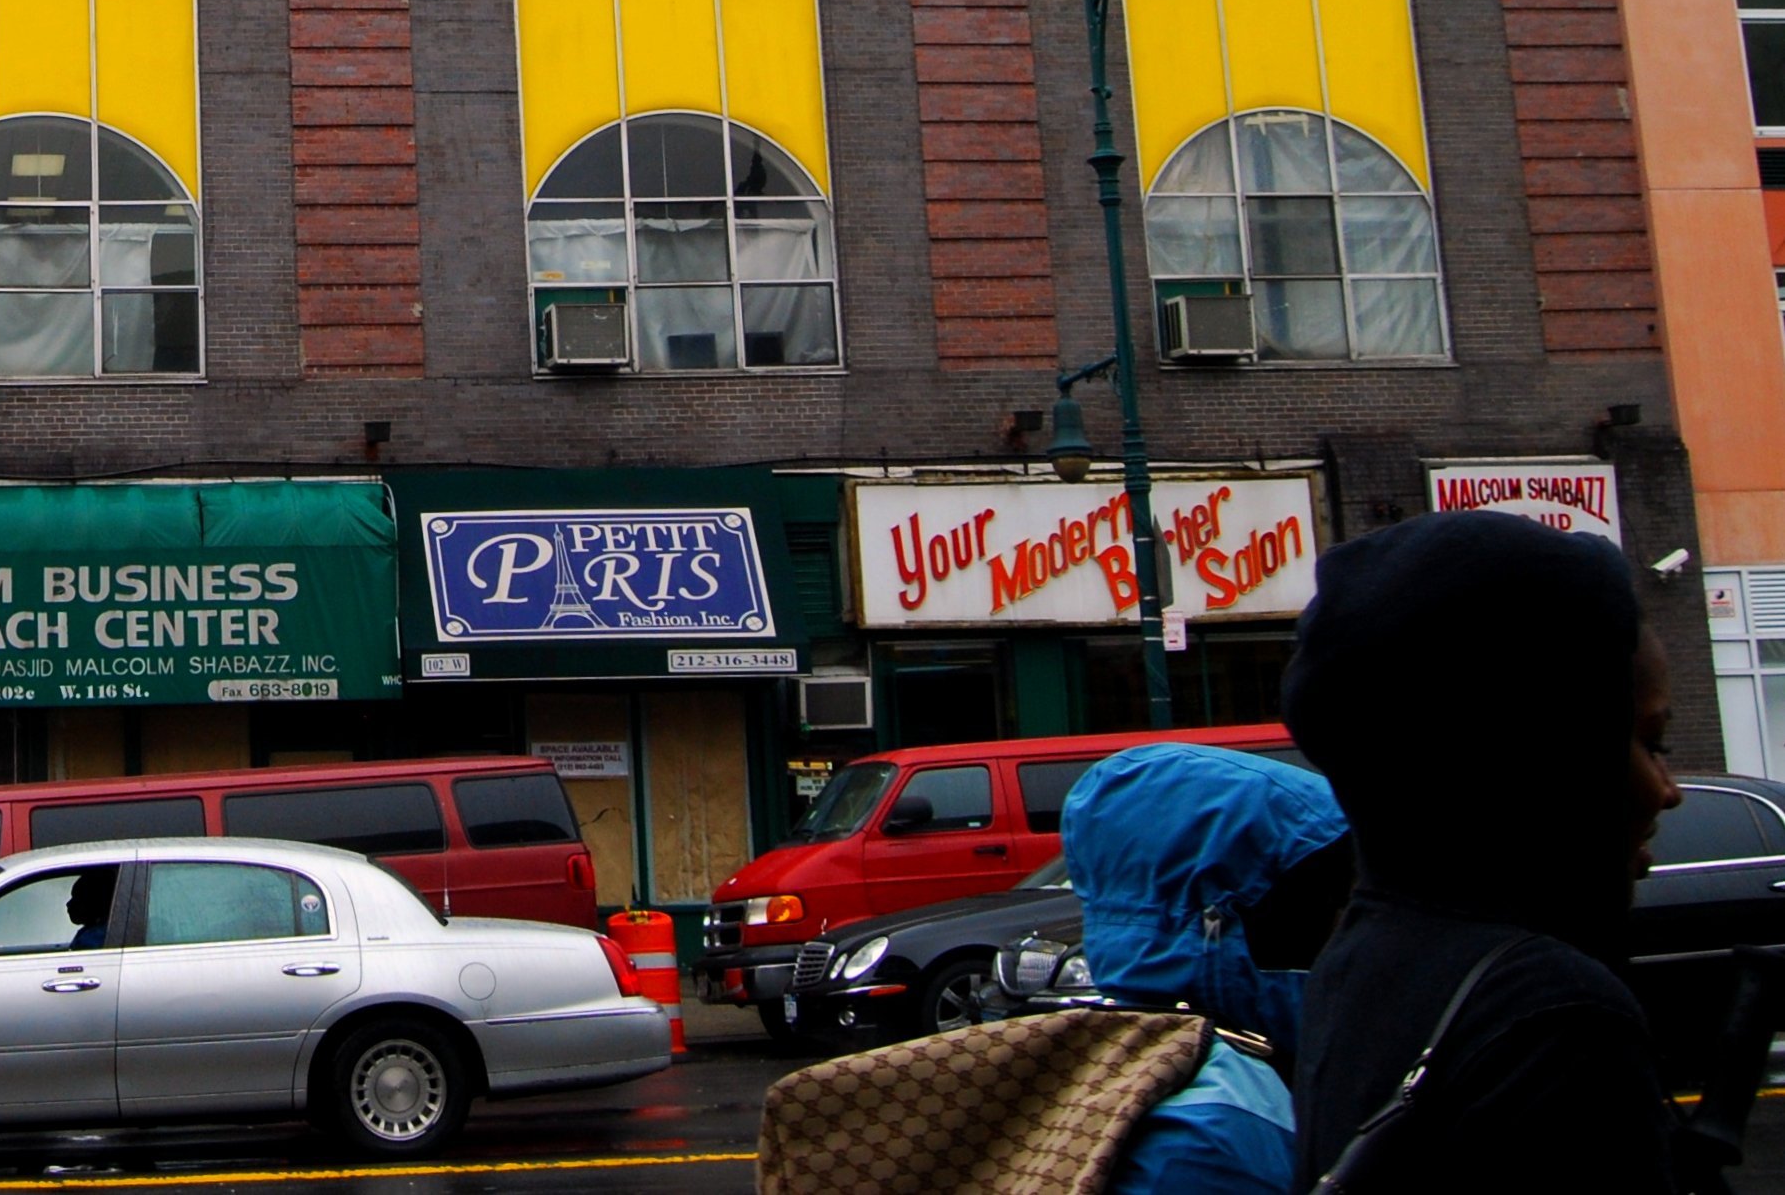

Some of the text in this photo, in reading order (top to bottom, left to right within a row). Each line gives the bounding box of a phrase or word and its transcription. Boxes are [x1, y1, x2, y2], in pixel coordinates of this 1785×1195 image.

[1437, 476, 1609, 525] MALCOLM SHABAZZ
[567, 523, 717, 553] PETIT
[986, 491, 1133, 615] Modern
[1093, 486, 1231, 613] Bber
[888, 507, 995, 611] Your
[1196, 515, 1303, 610] Salon
[43, 563, 299, 602] BUSINESS
[94, 609, 280, 648] CENTER
[618, 610, 735, 627] Fashion, Inc.
[66, 658, 174, 676] MALCOLM
[301, 656, 340, 673] INC.
[675, 654, 790, 667] 212-316-3448
[59, 684, 81, 699] W.
[86, 684, 117, 699] 116
[122, 683, 150, 698] St.
[221, 680, 330, 698] Fax 663-8019
